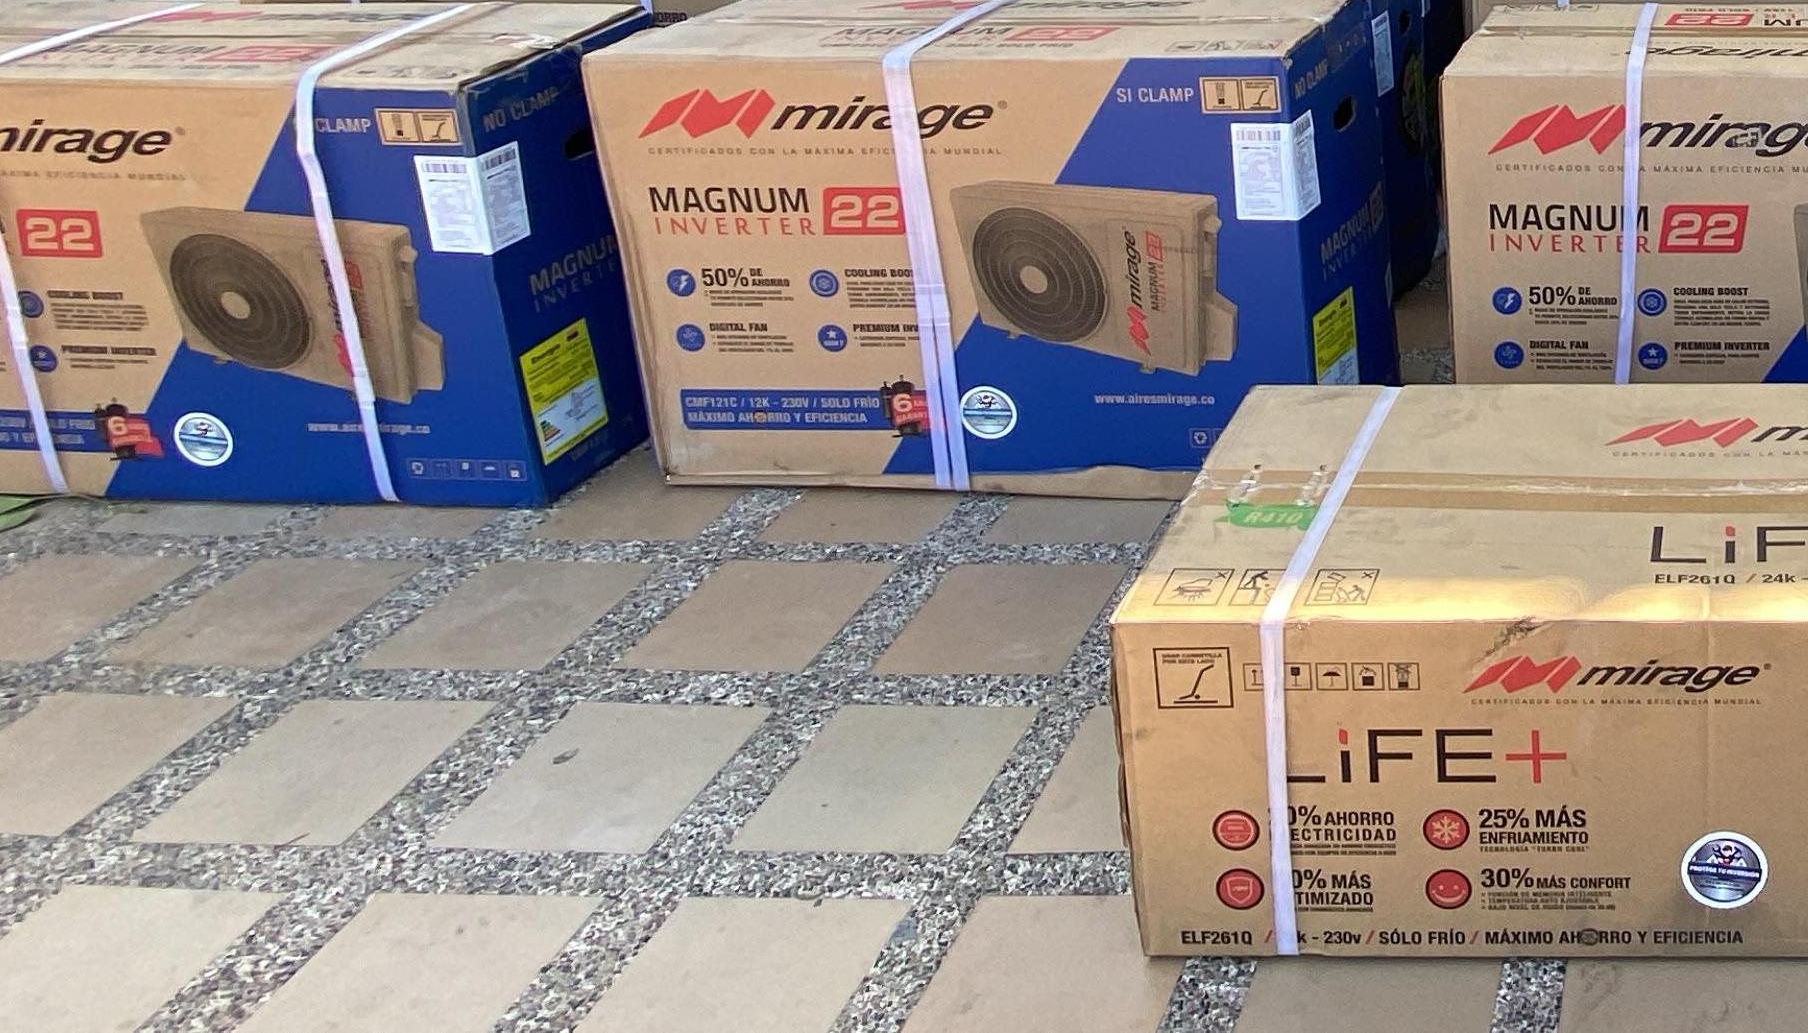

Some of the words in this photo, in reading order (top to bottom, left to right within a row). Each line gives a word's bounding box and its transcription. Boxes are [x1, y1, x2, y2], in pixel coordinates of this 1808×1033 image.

[1116, 87, 1133, 103] SI
[1137, 87, 1195, 104] CLAMP
[315, 116, 372, 136] CLAMP
[483, 107, 507, 134] NO
[771, 95, 995, 141] mirage
[1495, 163, 1593, 174] CERTIFICADOS
[1709, 165, 1786, 175] EFICIENCIA
[648, 186, 811, 214] MAGNUM
[830, 194, 900, 229] 22
[24, 216, 95, 252] 22
[654, 216, 817, 236] INVERTER
[1666, 213, 1740, 248] 22
[701, 268, 750, 288] 50%
[1124, 230, 1143, 310] mirage
[1528, 286, 1576, 306] 50%
[1577, 286, 1591, 297] DE
[1578, 297, 1618, 306] AHORRO
[1673, 286, 1715, 297] COOLING
[1717, 287, 1749, 297] BOOST
[748, 323, 768, 333] FAN
[1529, 340, 1568, 350] DIGITAL
[1569, 340, 1590, 350] FAN
[1674, 341, 1722, 351] PREMIUM
[1724, 341, 1771, 351] INVERTER
[893, 393, 911, 414] 6
[1654, 573, 1736, 585] ELF261Q
[1762, 572, 1797, 584] 24k
[1576, 659, 1762, 693] mirage
[1325, 811, 1395, 826] AHORRO
[1478, 808, 1530, 829] 25%
[1535, 804, 1587, 829] MÁS
[1289, 827, 1397, 842] ECTRICIDAD
[1479, 831, 1589, 845] ENFRIAMIENTO
[1331, 870, 1372, 890] MÁS
[1480, 867, 1535, 889] 30%
[1536, 874, 1567, 889] MÁS
[1570, 876, 1631, 889] CONFORT
[1296, 891, 1374, 906] TIMIZADO
[1181, 929, 1253, 945] ELF261Q
[1323, 930, 1362, 945] 230v
[1378, 927, 1422, 945] SÓLO
[1428, 927, 1466, 945] FRÍO
[1485, 927, 1554, 945] MÁXIMO
[1558, 928, 1632, 946] AHORRO
[1637, 930, 1647, 945] Y
[1653, 930, 1744, 945] EFICIENCIA
